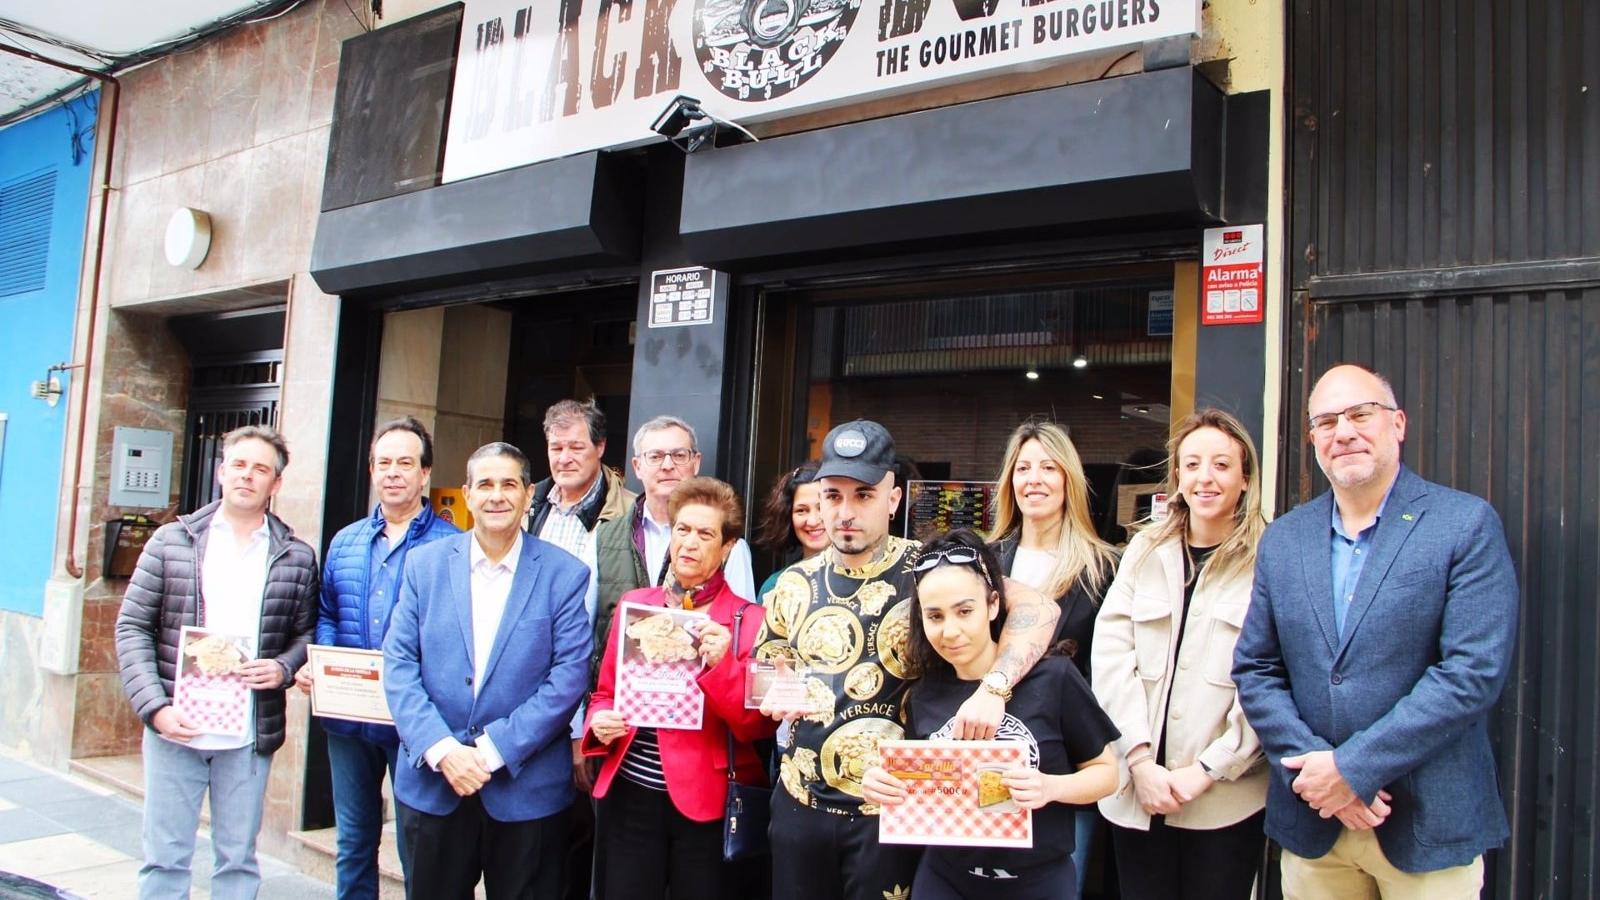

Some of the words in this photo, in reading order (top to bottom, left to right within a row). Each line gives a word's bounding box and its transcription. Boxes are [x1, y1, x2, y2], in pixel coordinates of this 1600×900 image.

[711, 16, 839, 70] BLACK
[876, 45, 910, 77] THE
[919, 19, 1023, 67] GOURMET
[1033, 0, 1160, 44] BURGUERS
[463, 0, 682, 143] BLACK
[723, 53, 822, 88] BULL
[665, 272, 700, 283] HORARIO
[1207, 267, 1258, 281] Alarma
[867, 621, 879, 657] VERSACE
[839, 702, 895, 720] VERSACE
